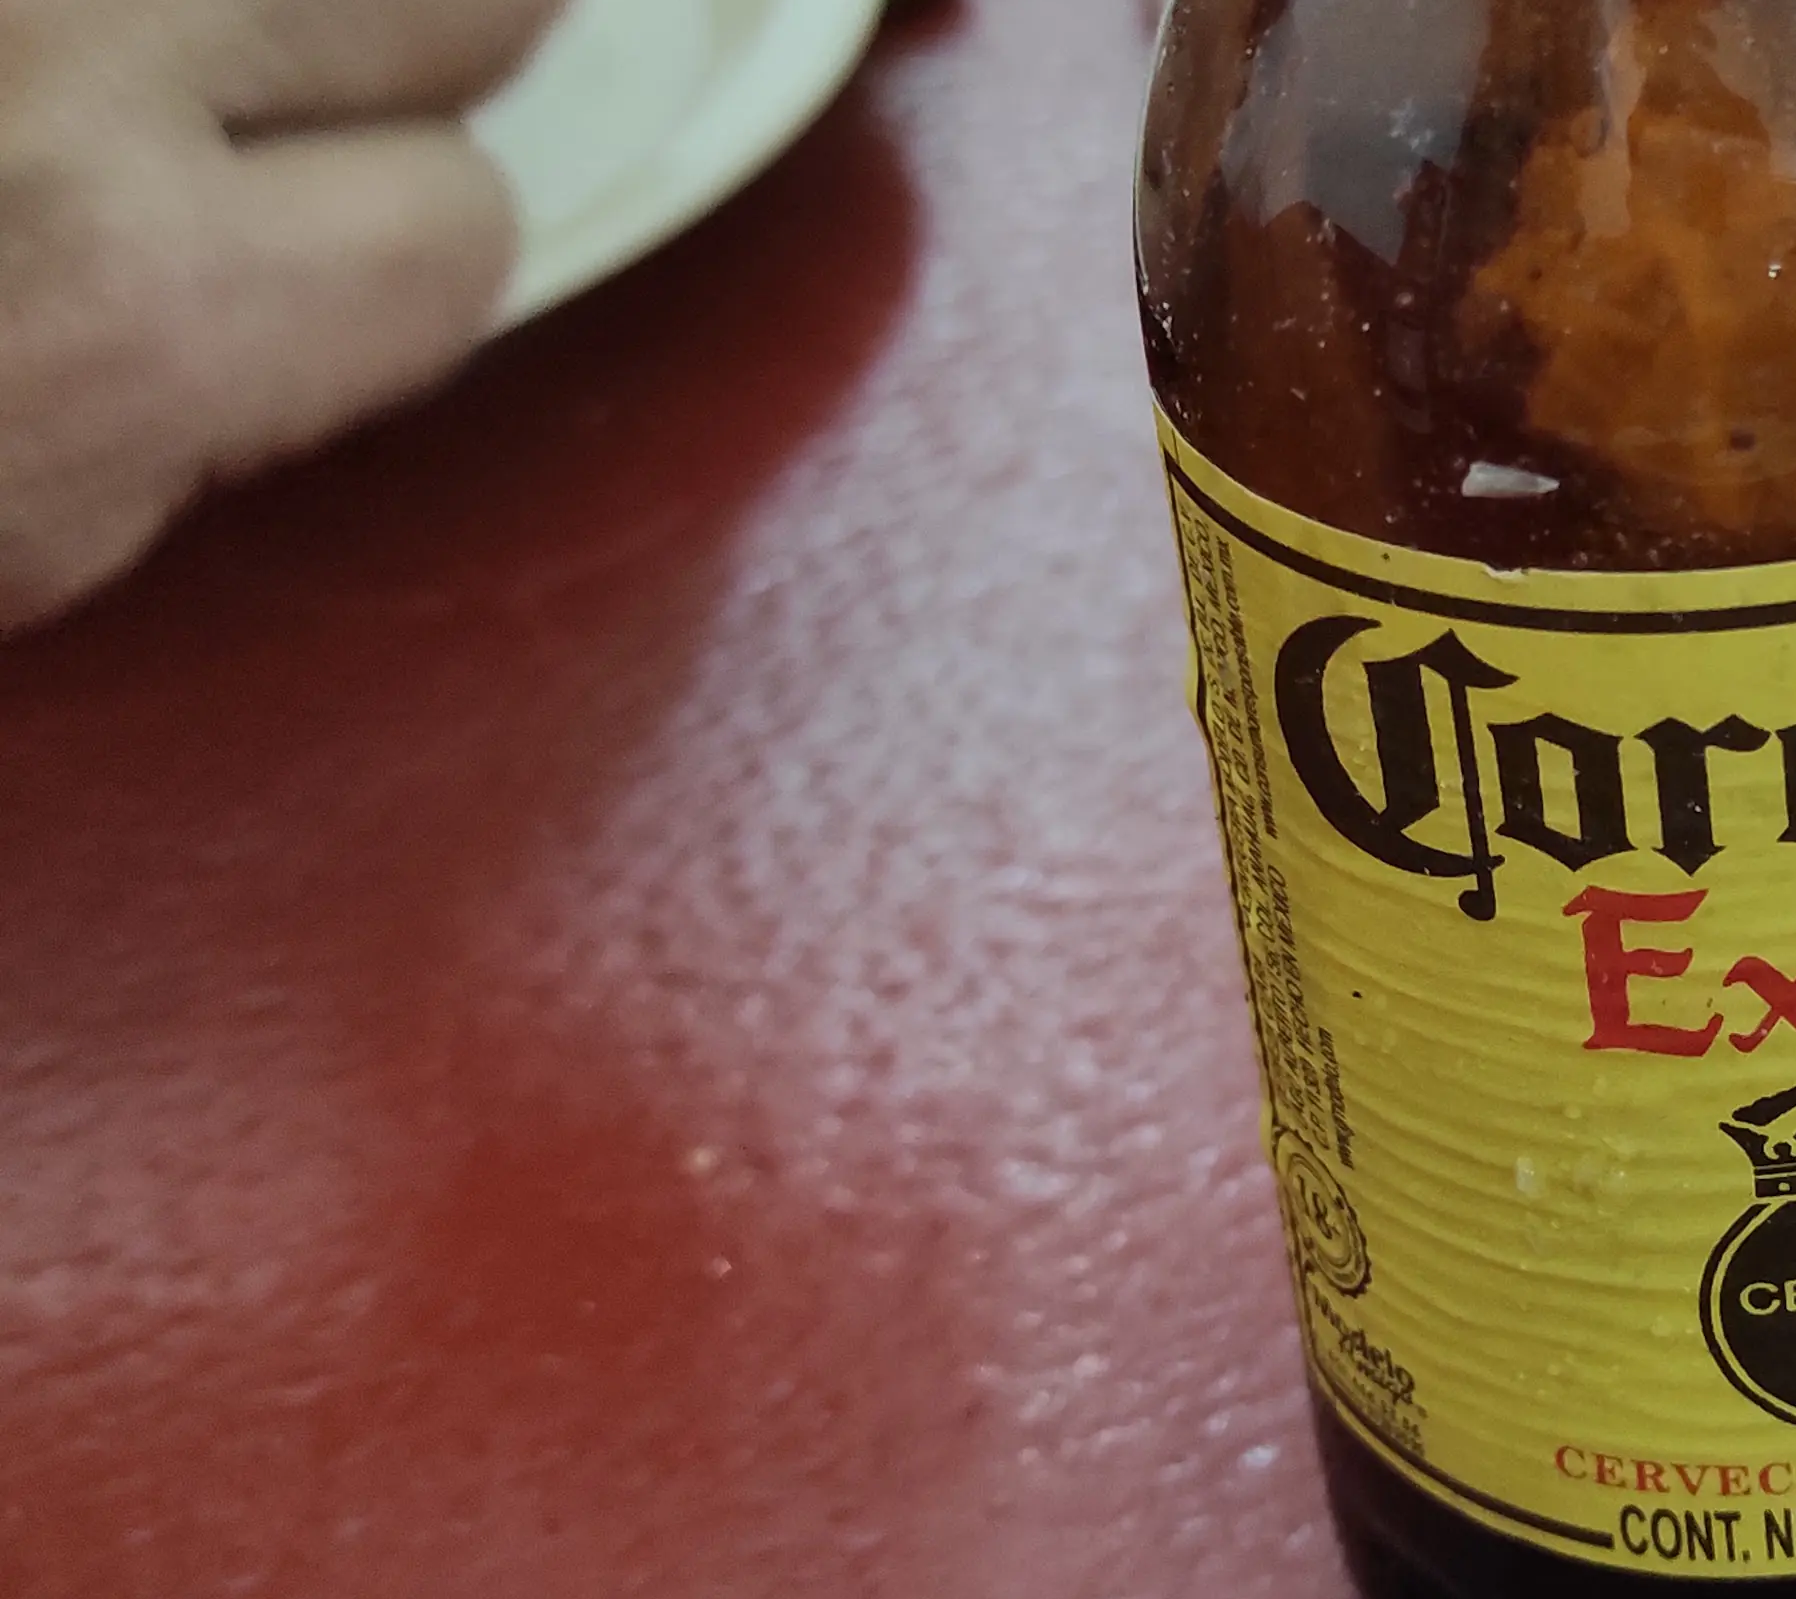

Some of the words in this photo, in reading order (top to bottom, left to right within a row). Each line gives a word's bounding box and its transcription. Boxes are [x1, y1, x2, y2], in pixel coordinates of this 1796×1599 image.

[1267, 864, 1298, 951] MEXICO
[1281, 949, 1302, 981] EN
[1285, 979, 1315, 1056] HECHO
[1619, 1503, 1751, 1564] CONT.
